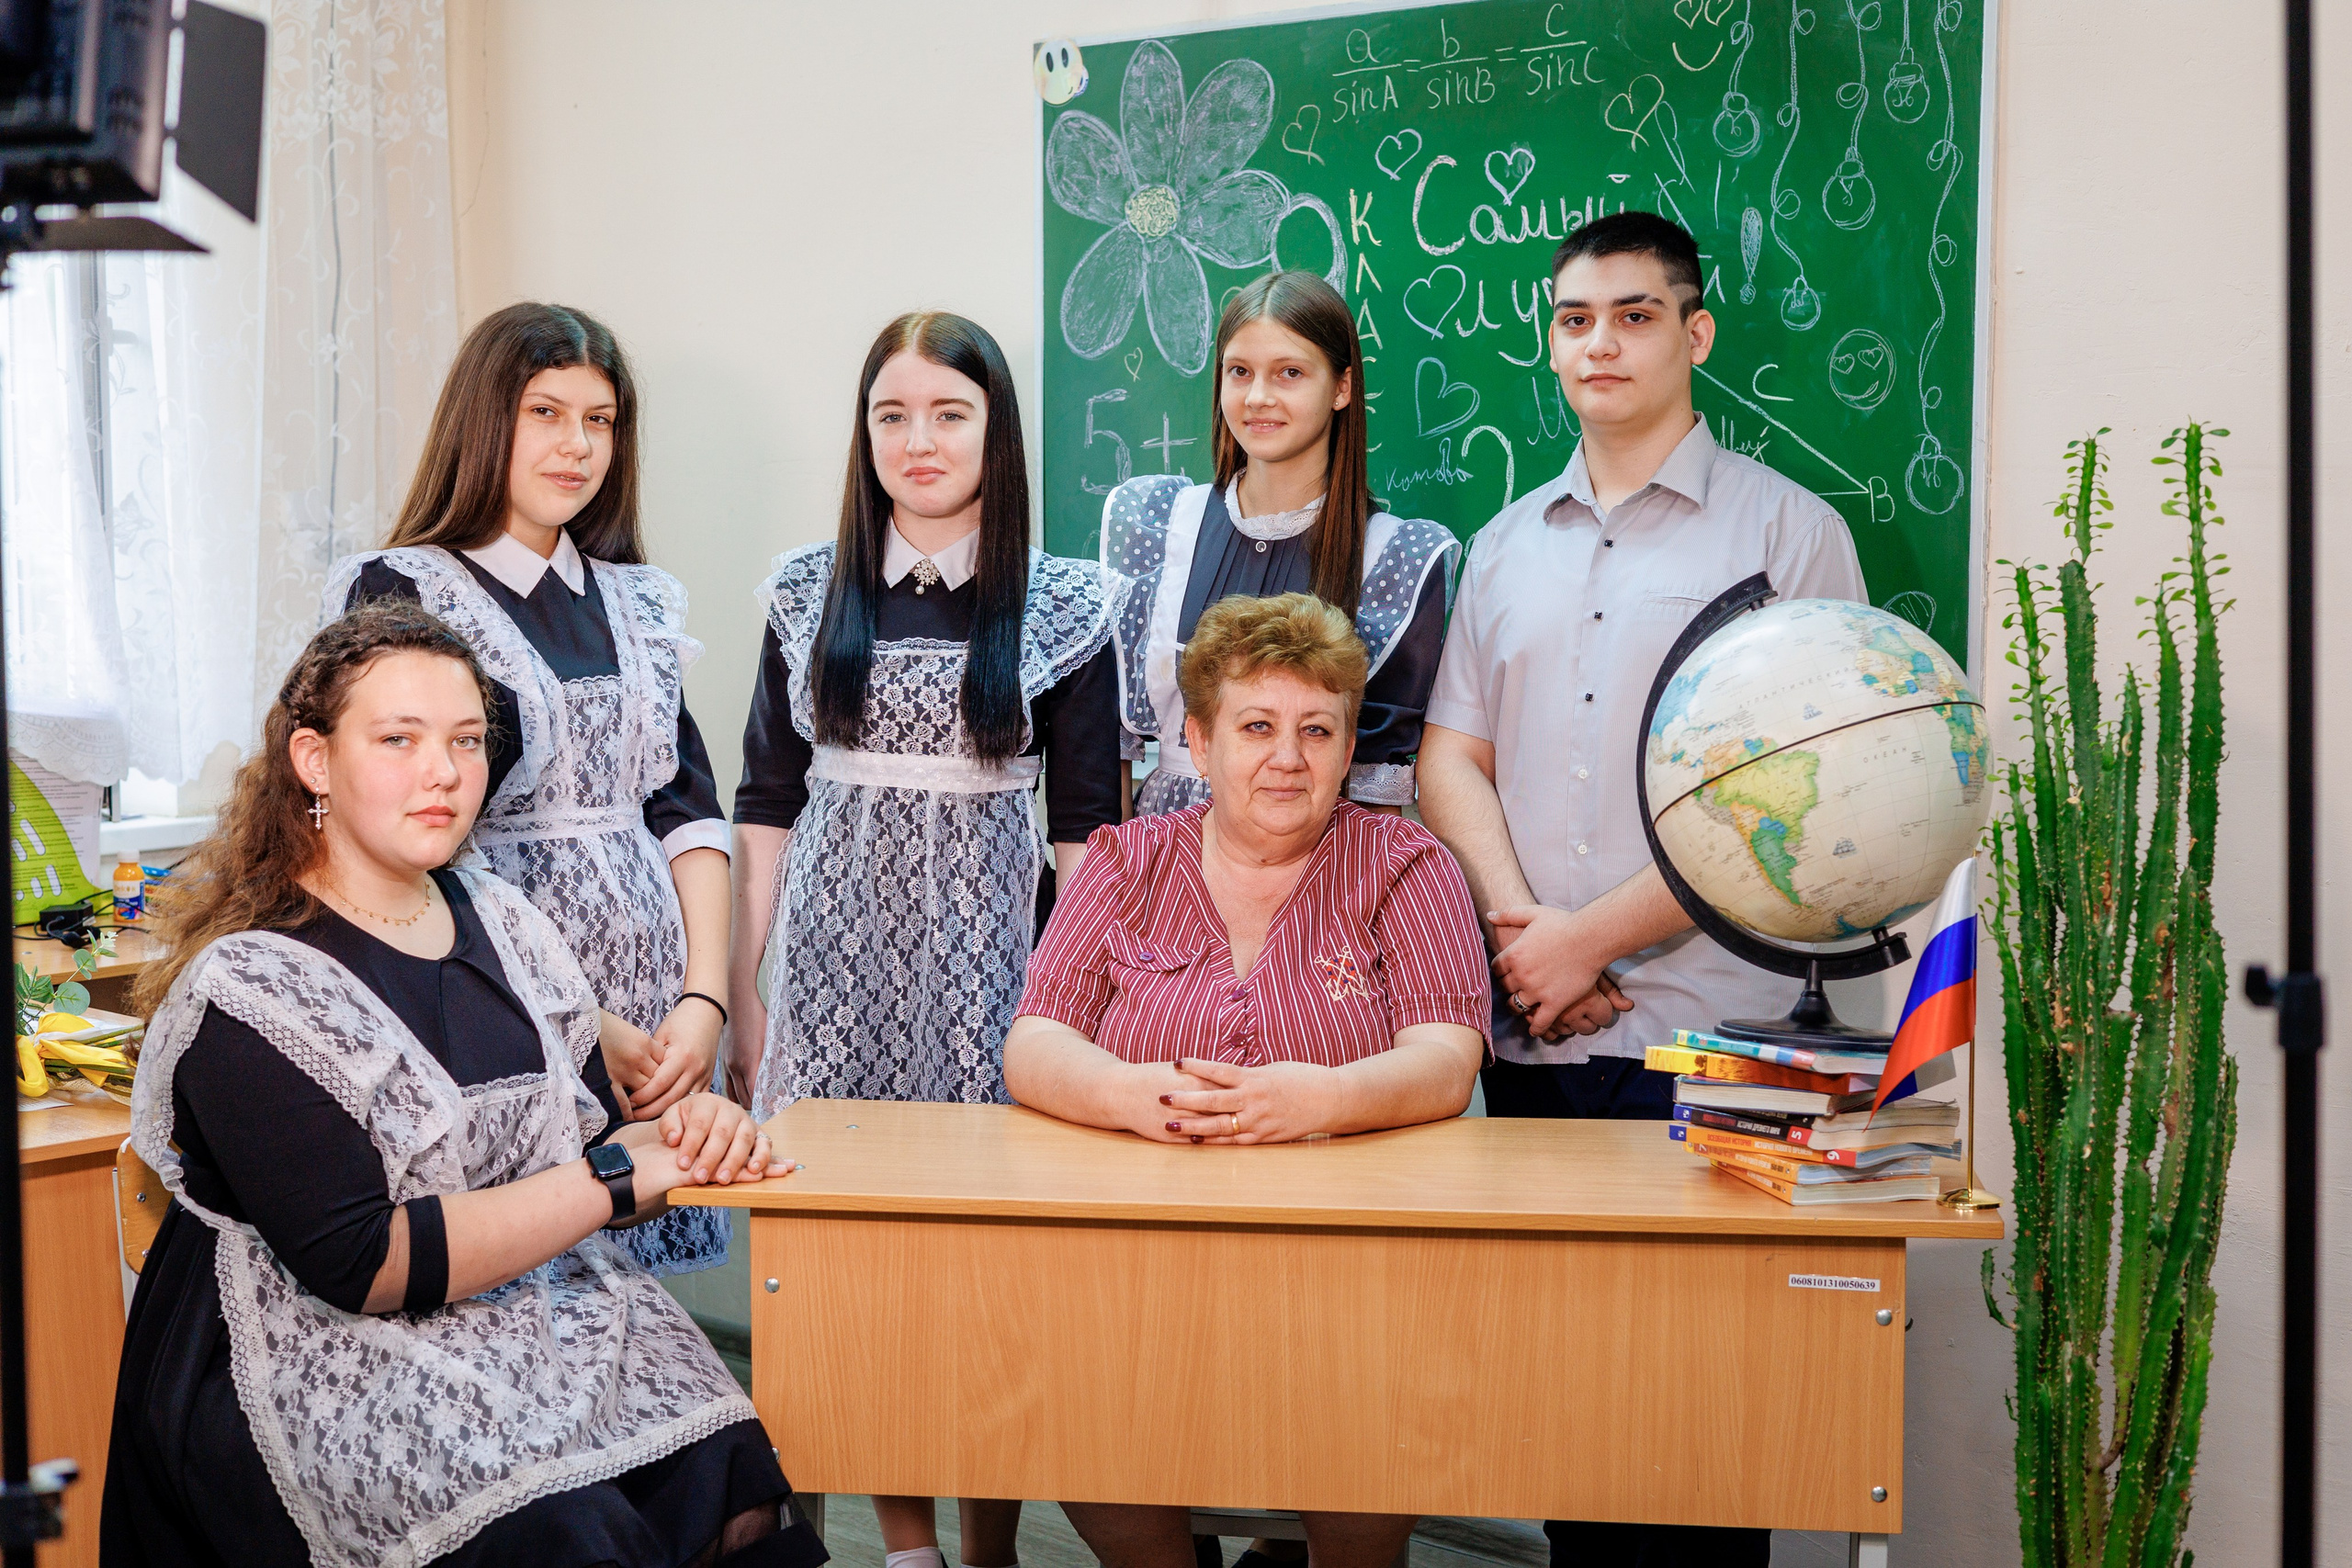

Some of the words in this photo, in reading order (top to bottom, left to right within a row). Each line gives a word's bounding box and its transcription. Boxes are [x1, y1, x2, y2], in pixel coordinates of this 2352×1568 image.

[1441, 18, 1460, 59] b
[1427, 66, 1496, 109] sinB
[1791, 1130, 1803, 1140] 5
[1791, 1276, 1876, 1290] 0608101310050639
